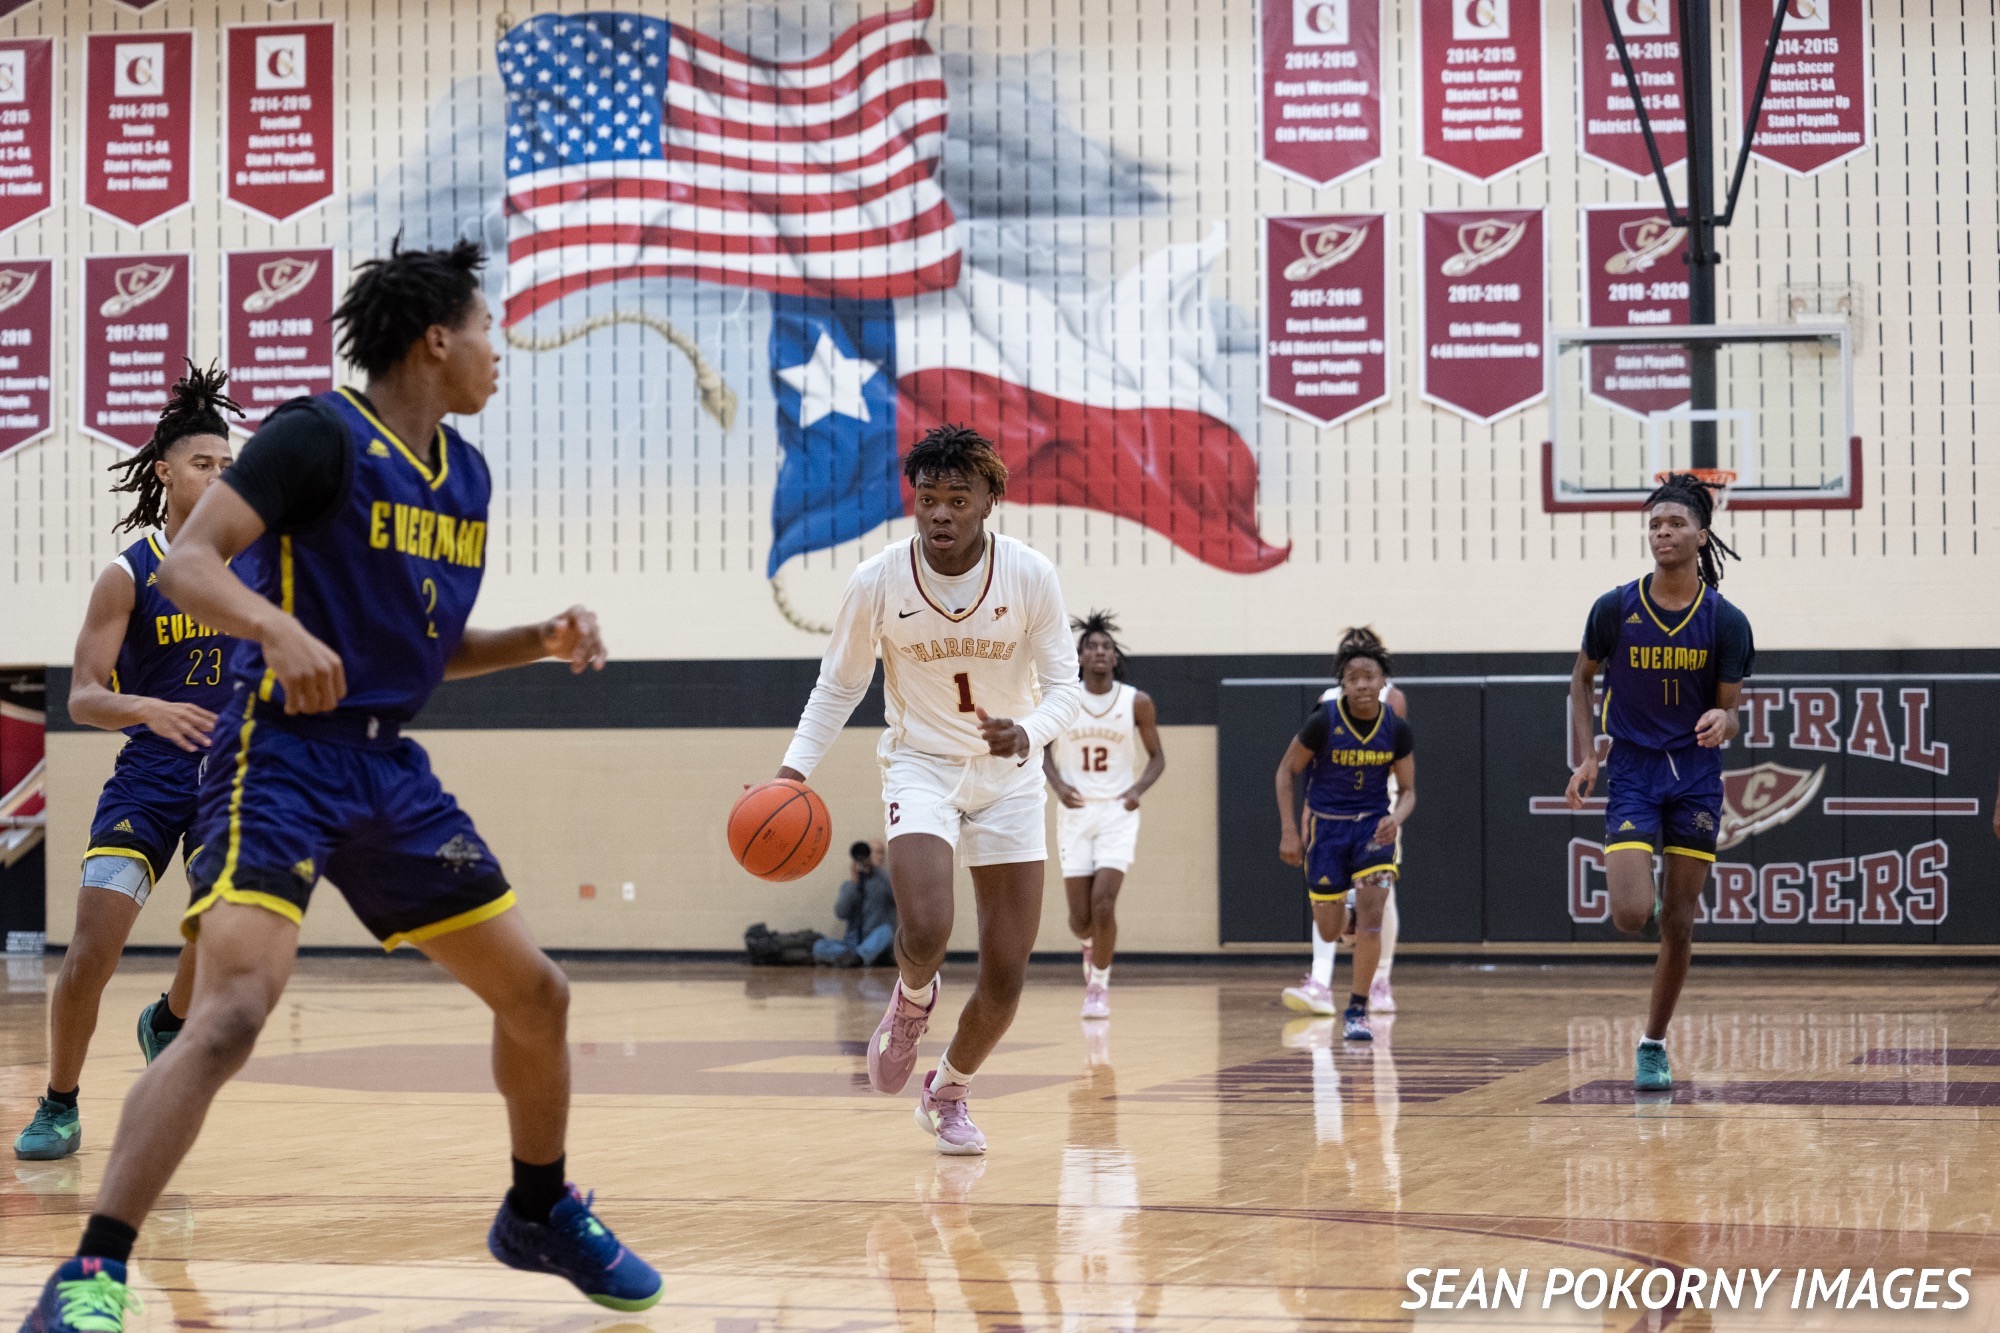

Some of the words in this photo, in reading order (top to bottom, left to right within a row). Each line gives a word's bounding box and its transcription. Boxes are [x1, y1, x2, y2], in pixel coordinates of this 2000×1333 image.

[1446, 46, 1517, 64] 2014-2015
[1765, 38, 1839, 55] 014-2015
[1284, 50, 1358, 70] 2014-2015
[1797, 60, 1835, 75] Soccer
[1441, 69, 1474, 84] Cross
[1476, 68, 1522, 84] Country
[1611, 72, 1640, 87] Bos
[1640, 70, 1676, 86] Track
[1770, 78, 1810, 92] District
[1810, 78, 1836, 92] 5-6A
[1274, 81, 1306, 98] Boys
[1306, 79, 1369, 97] Wrestling
[1446, 88, 1488, 103] District
[1489, 86, 1518, 102] 5-6A
[108, 102, 169, 119] 2014-2015
[250, 95, 312, 113] 2014-2015
[1282, 103, 1330, 120] District
[1330, 102, 1362, 118] 5-6A
[1761, 96, 1796, 110] istrict
[1796, 96, 1834, 110] Runner
[1835, 94, 1851, 110] Up
[1442, 107, 1492, 123] Regional
[1768, 114, 1796, 128] State
[1796, 112, 1840, 128] Playoffs
[1298, 126, 1334, 142] Place
[1334, 124, 1368, 142] State
[1442, 127, 1473, 142] Team
[1474, 125, 1524, 142] Qualifier
[1588, 119, 1632, 134] District
[248, 134, 286, 149] District
[1752, 132, 1800, 146] i-District
[1801, 131, 1861, 145] Champions
[106, 141, 143, 155] District
[103, 159, 130, 174] State
[130, 158, 172, 174] Playoffs
[245, 152, 273, 167] State
[273, 151, 315, 167] Playoffs
[131, 176, 168, 190] Finalist
[1290, 287, 1362, 307] 2017-2018
[1448, 284, 1520, 303] 2017-2018
[105, 323, 169, 342] 2017-2018
[248, 317, 314, 338] 2017-2018
[1292, 360, 1320, 376] State
[1320, 358, 1362, 376] Playoffs
[1615, 354, 1642, 370] State
[1643, 354, 1686, 370] Playoffs
[422, 577, 439, 639] 2
[185, 648, 222, 686] 23
[1629, 646, 1708, 671] EVERMAN
[954, 672, 976, 713] 1
[1661, 678, 1680, 706] 11
[1567, 687, 1949, 776] CTRAL
[1082, 745, 1108, 772] 12
[1353, 770, 1365, 791] 3
[889, 802, 901, 826] C
[1568, 837, 1949, 925] CRGERS
